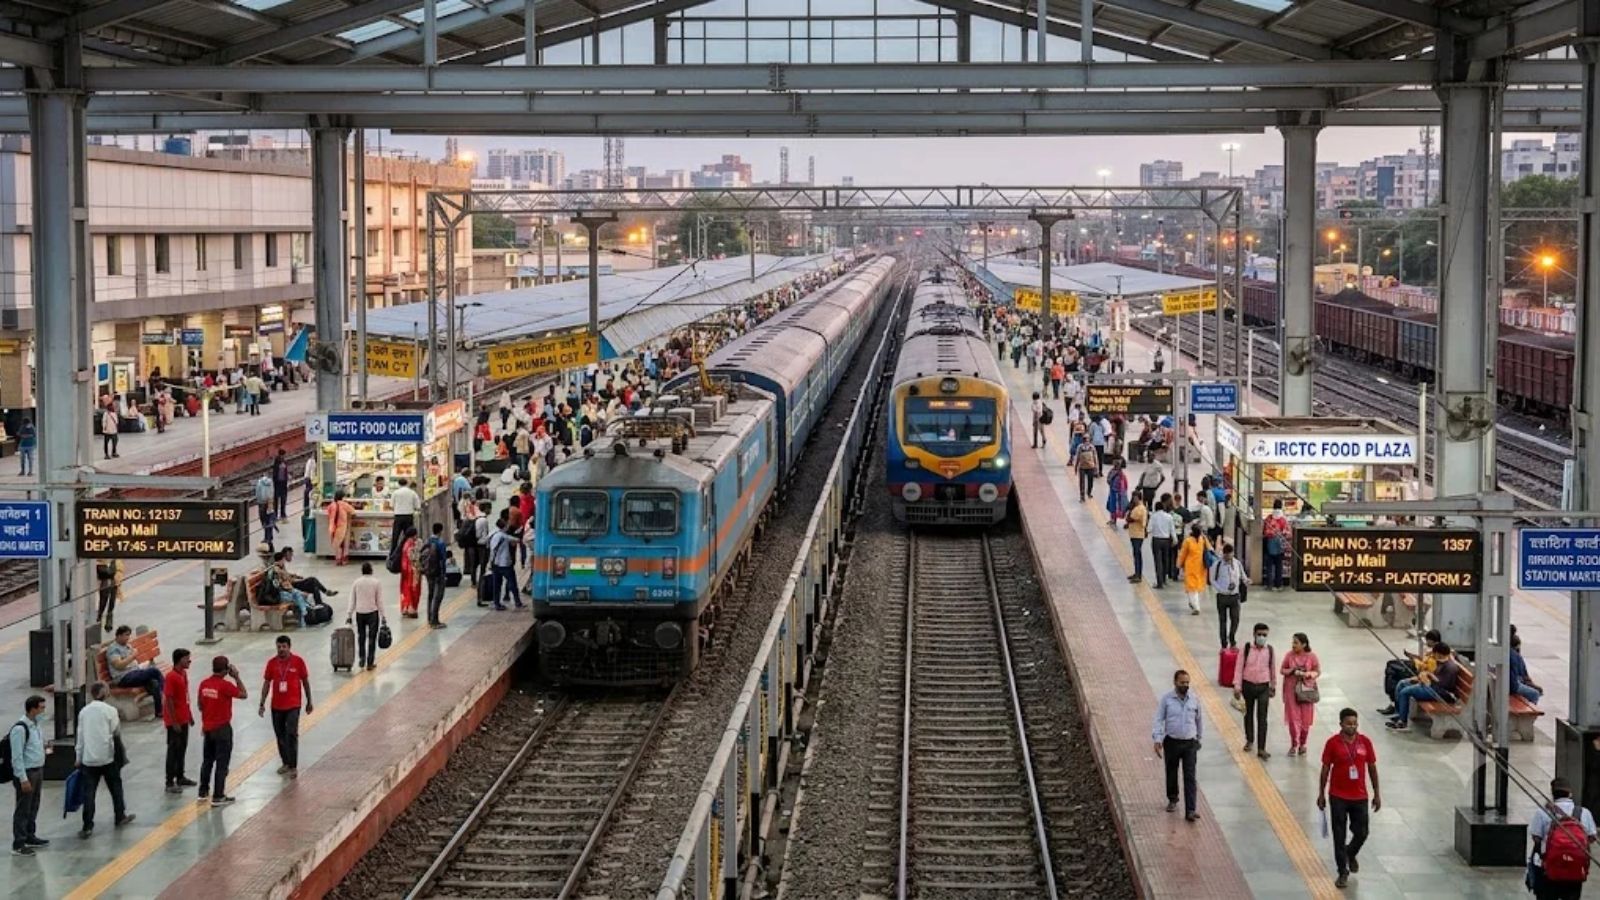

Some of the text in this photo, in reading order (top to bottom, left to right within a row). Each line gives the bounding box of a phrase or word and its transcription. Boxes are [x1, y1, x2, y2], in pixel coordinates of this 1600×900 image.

[584, 341, 592, 356] 2
[497, 363, 512, 374] TO
[360, 421, 386, 435] FOOD
[1274, 441, 1412, 458] IRCTC FOOD PLAZA
[83, 508, 120, 520] TRAIN
[148, 509, 182, 520] 12137
[84, 523, 158, 539] Punjab Mail
[117, 541, 147, 552] 17:45
[157, 541, 224, 552] PLATFORM
[226, 541, 235, 553] 2
[1303, 537, 1345, 549] TRAIN
[1303, 553, 1387, 570] Punjab Mail
[1576, 555, 1600, 565] ROO
[1303, 571, 1335, 584] DEP:
[1338, 571, 1374, 584] 17:45
[1385, 572, 1460, 585] PLATFORM
[1462, 573, 1472, 586] 2
